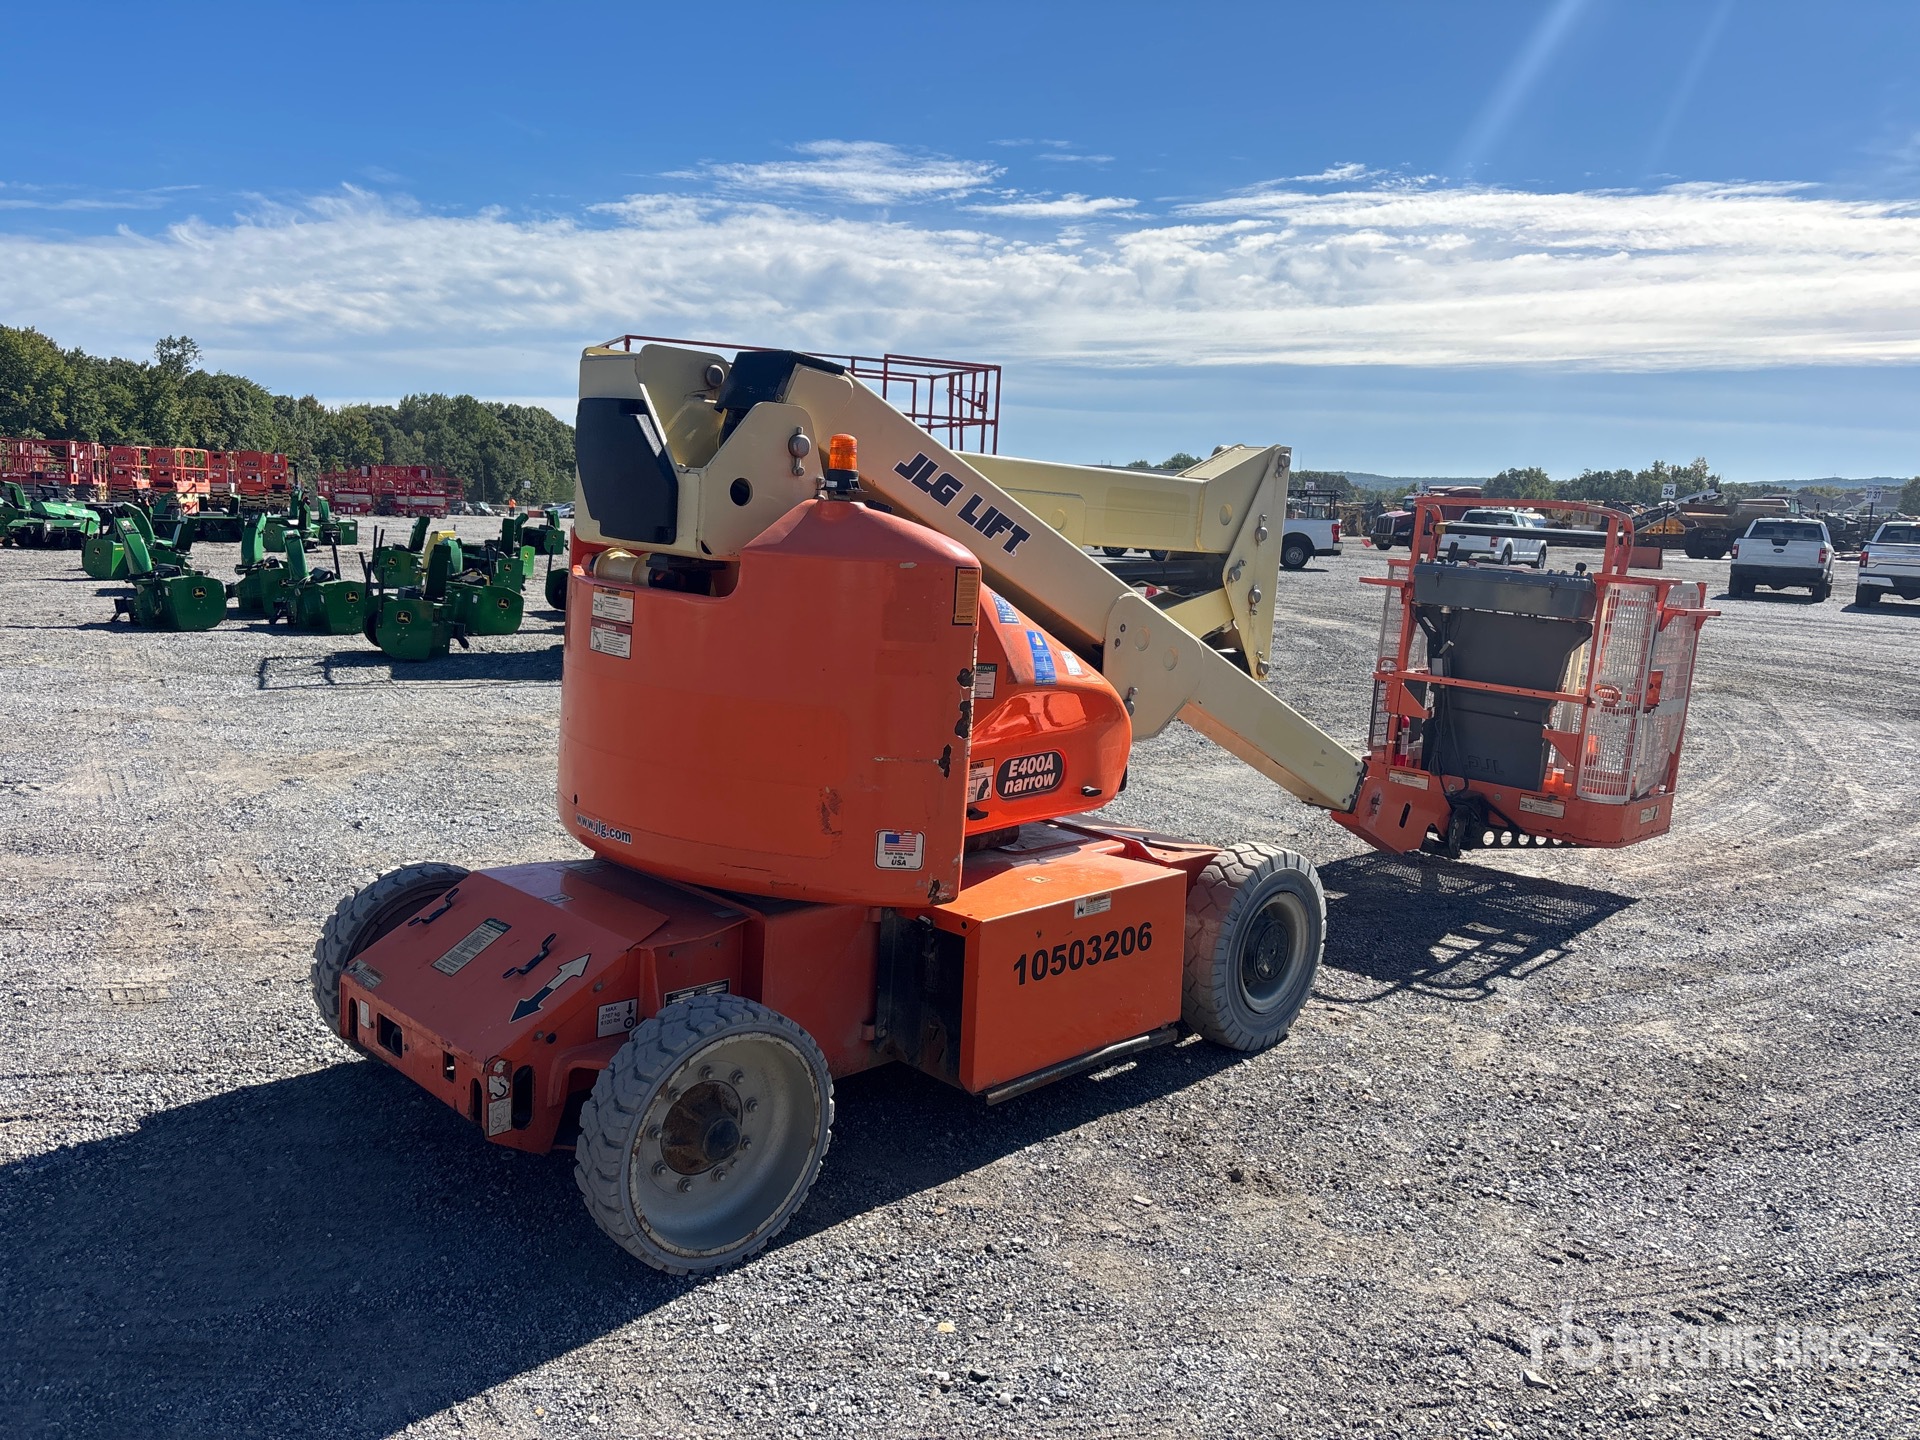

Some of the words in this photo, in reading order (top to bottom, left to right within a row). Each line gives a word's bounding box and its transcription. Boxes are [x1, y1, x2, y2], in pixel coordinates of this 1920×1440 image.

[892, 451, 965, 508] JLG
[956, 492, 1032, 555] LIFT
[1663, 487, 1675, 496] 36
[1008, 753, 1054, 778] E400A
[1004, 772, 1056, 794] narrow
[576, 812, 632, 844] www.jlg.com
[1013, 922, 1152, 986] 10503206
[605, 1005, 618, 1013] MAX
